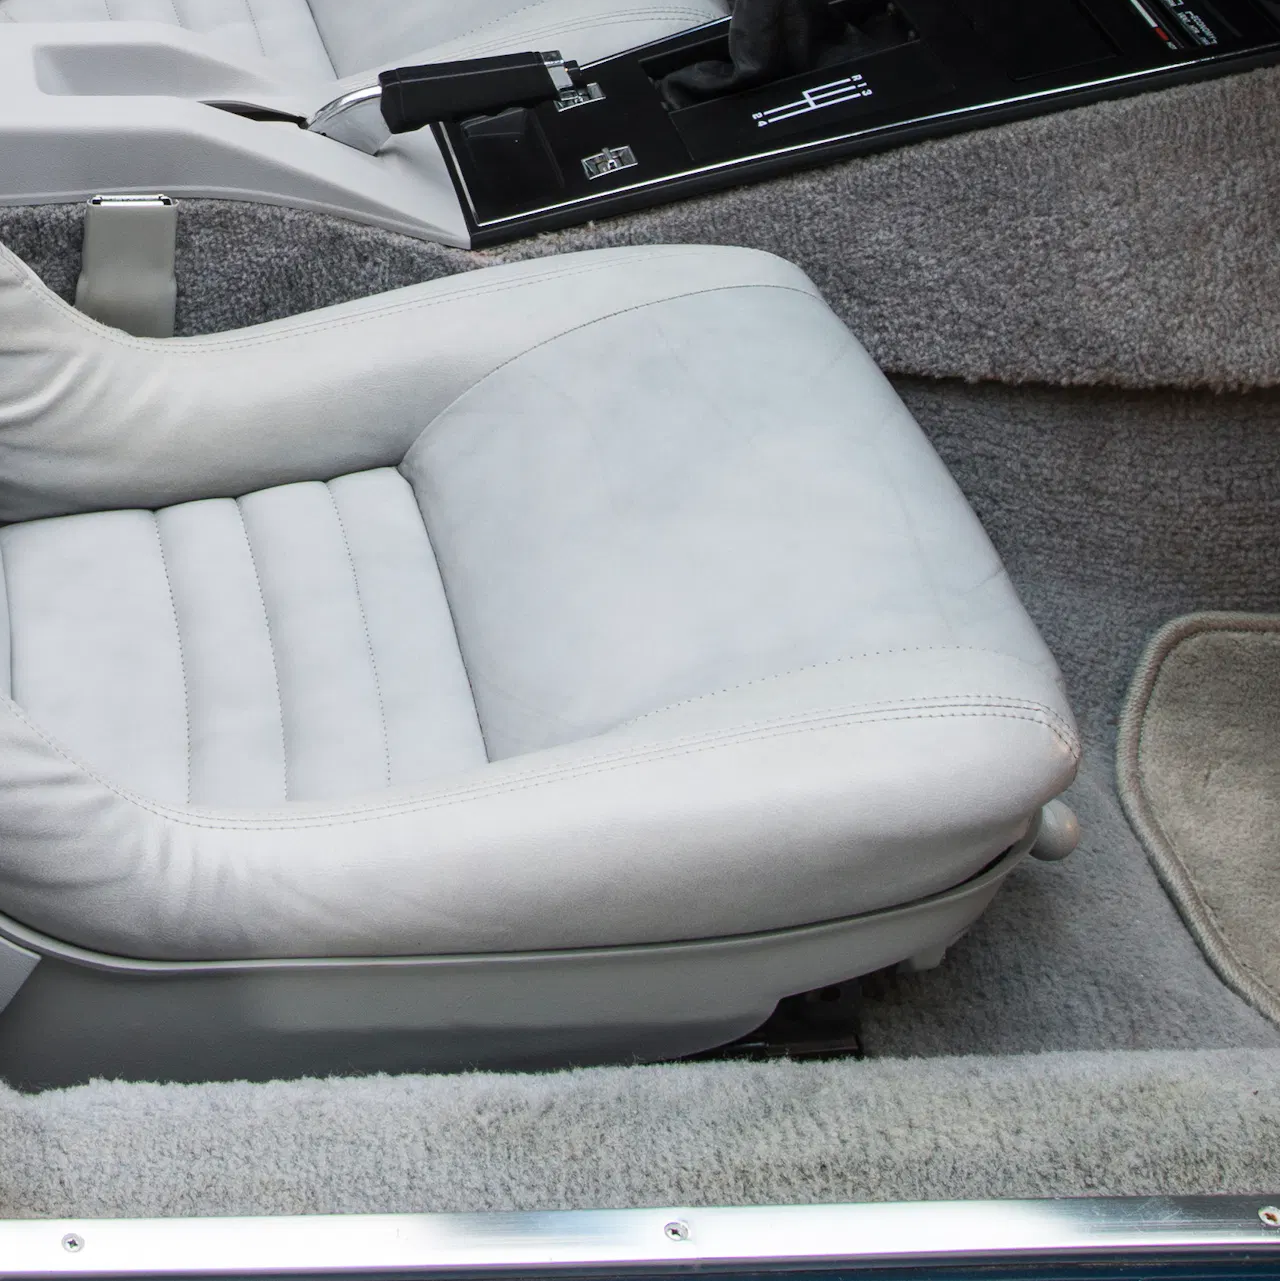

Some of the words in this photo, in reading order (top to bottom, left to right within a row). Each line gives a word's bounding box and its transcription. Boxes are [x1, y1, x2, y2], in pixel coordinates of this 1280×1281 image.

[1190, 14, 1217, 40] ECONOMY
[861, 89, 873, 97] 3
[751, 112, 763, 120] 2
